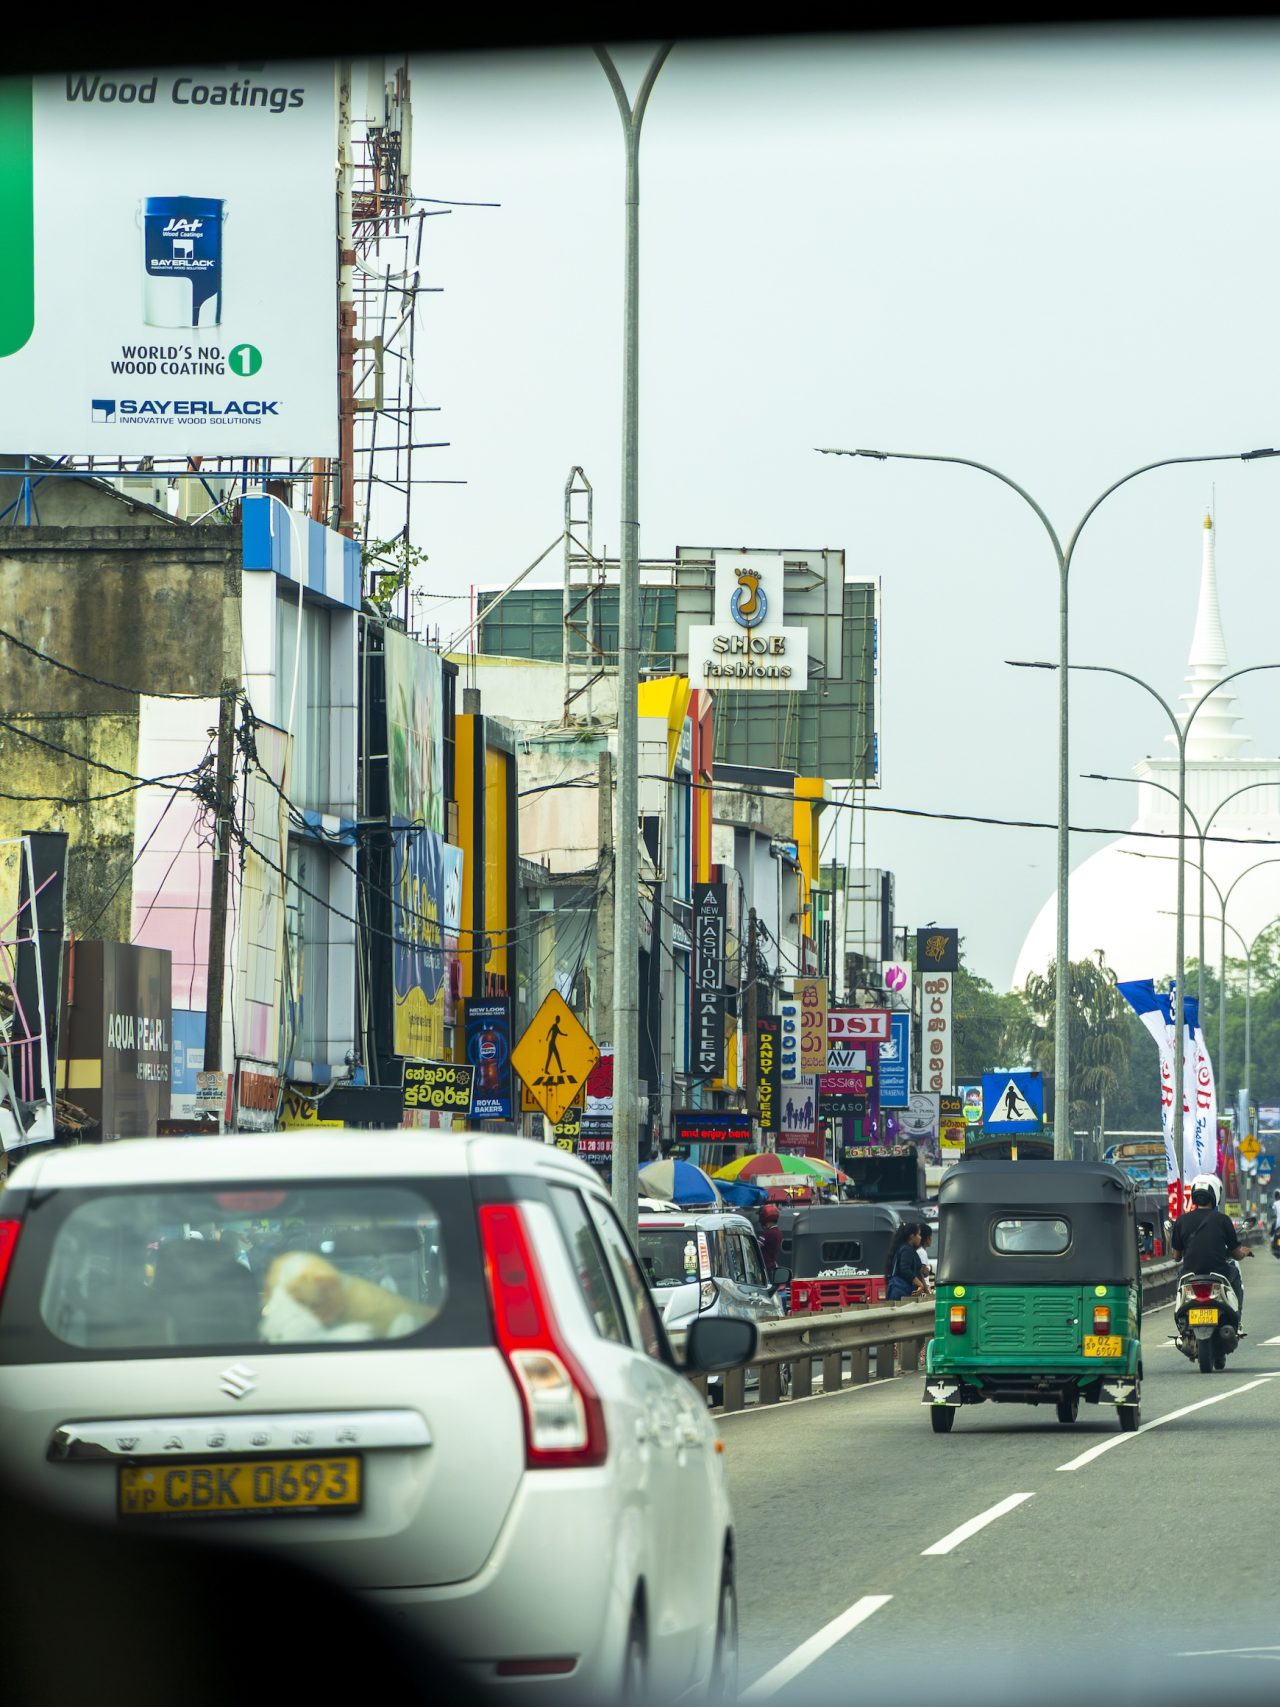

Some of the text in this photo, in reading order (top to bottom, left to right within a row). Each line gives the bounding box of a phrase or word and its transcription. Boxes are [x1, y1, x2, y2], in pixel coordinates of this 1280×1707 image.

[65, 73, 305, 114] Wood Coatings
[150, 259, 215, 267] SAYERLACK
[198, 347, 226, 360] NO.
[237, 347, 251, 375] 1
[110, 361, 226, 376] WOOD COATING
[119, 400, 280, 416] SAYERLACK
[119, 416, 262, 425] INNOVATIVE WOOD SOLUTIONS
[712, 635, 786, 655] SHOE
[702, 659, 793, 679] fashions
[700, 906, 719, 915] NEW
[702, 916, 717, 990] FASHION
[107, 1013, 169, 1052] AQUA PEARL
[700, 992, 717, 1074] GALLERY
[828, 1017, 881, 1034] DSI
[137, 1062, 169, 1082] JEWELLERS
[760, 1034, 774, 1127] DANDY LOVERS
[164, 1462, 350, 1508] CBK 0693
